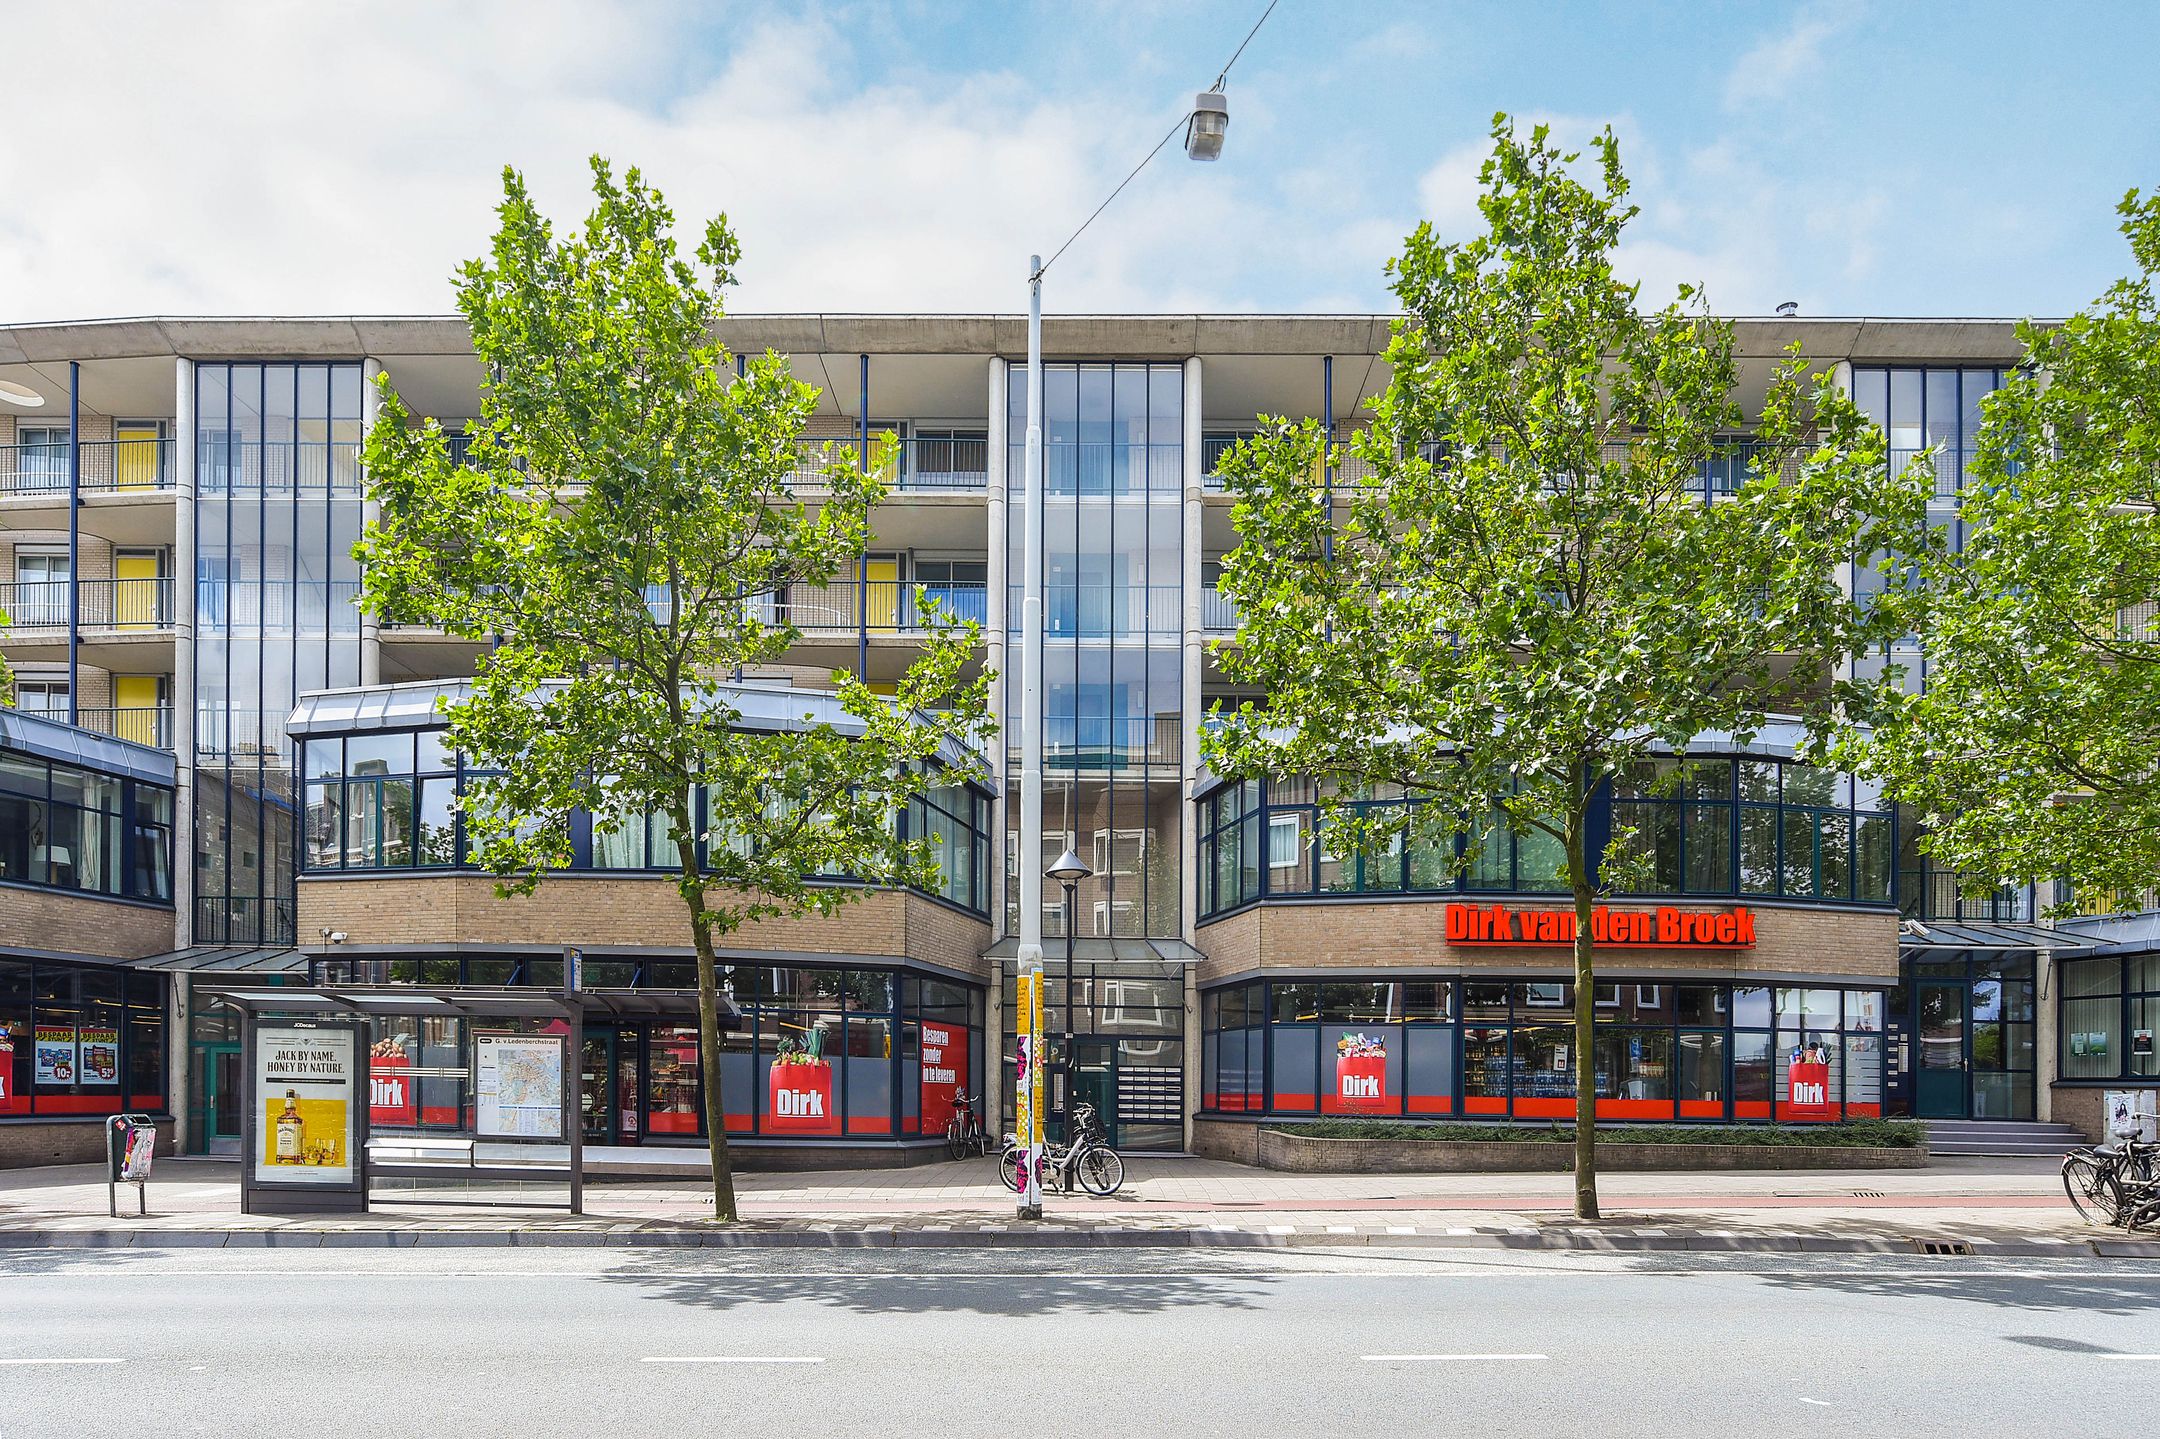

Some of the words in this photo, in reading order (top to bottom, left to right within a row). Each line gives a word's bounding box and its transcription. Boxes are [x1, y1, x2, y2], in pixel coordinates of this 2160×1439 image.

[1445, 904, 1513, 941] Dirk
[1519, 911, 1577, 941] van
[1591, 905, 1651, 942] den
[1656, 906, 1757, 943] Broek
[923, 1026, 949, 1045] Besparen
[276, 1050, 296, 1061] JACK
[298, 1050, 309, 1061] BY
[311, 1051, 337, 1062] NAME.
[923, 1046, 942, 1062] zonder
[267, 1062, 296, 1072] HONEY
[298, 1062, 308, 1073] BY
[310, 1063, 345, 1074] NATURE.
[923, 1065, 929, 1081] in
[929, 1066, 935, 1081] te
[935, 1066, 956, 1082] leveren
[370, 1078, 403, 1105] Dirk
[1343, 1075, 1380, 1096] Dirk
[1793, 1082, 1824, 1103] Dirk
[777, 1089, 824, 1116] Dirk
